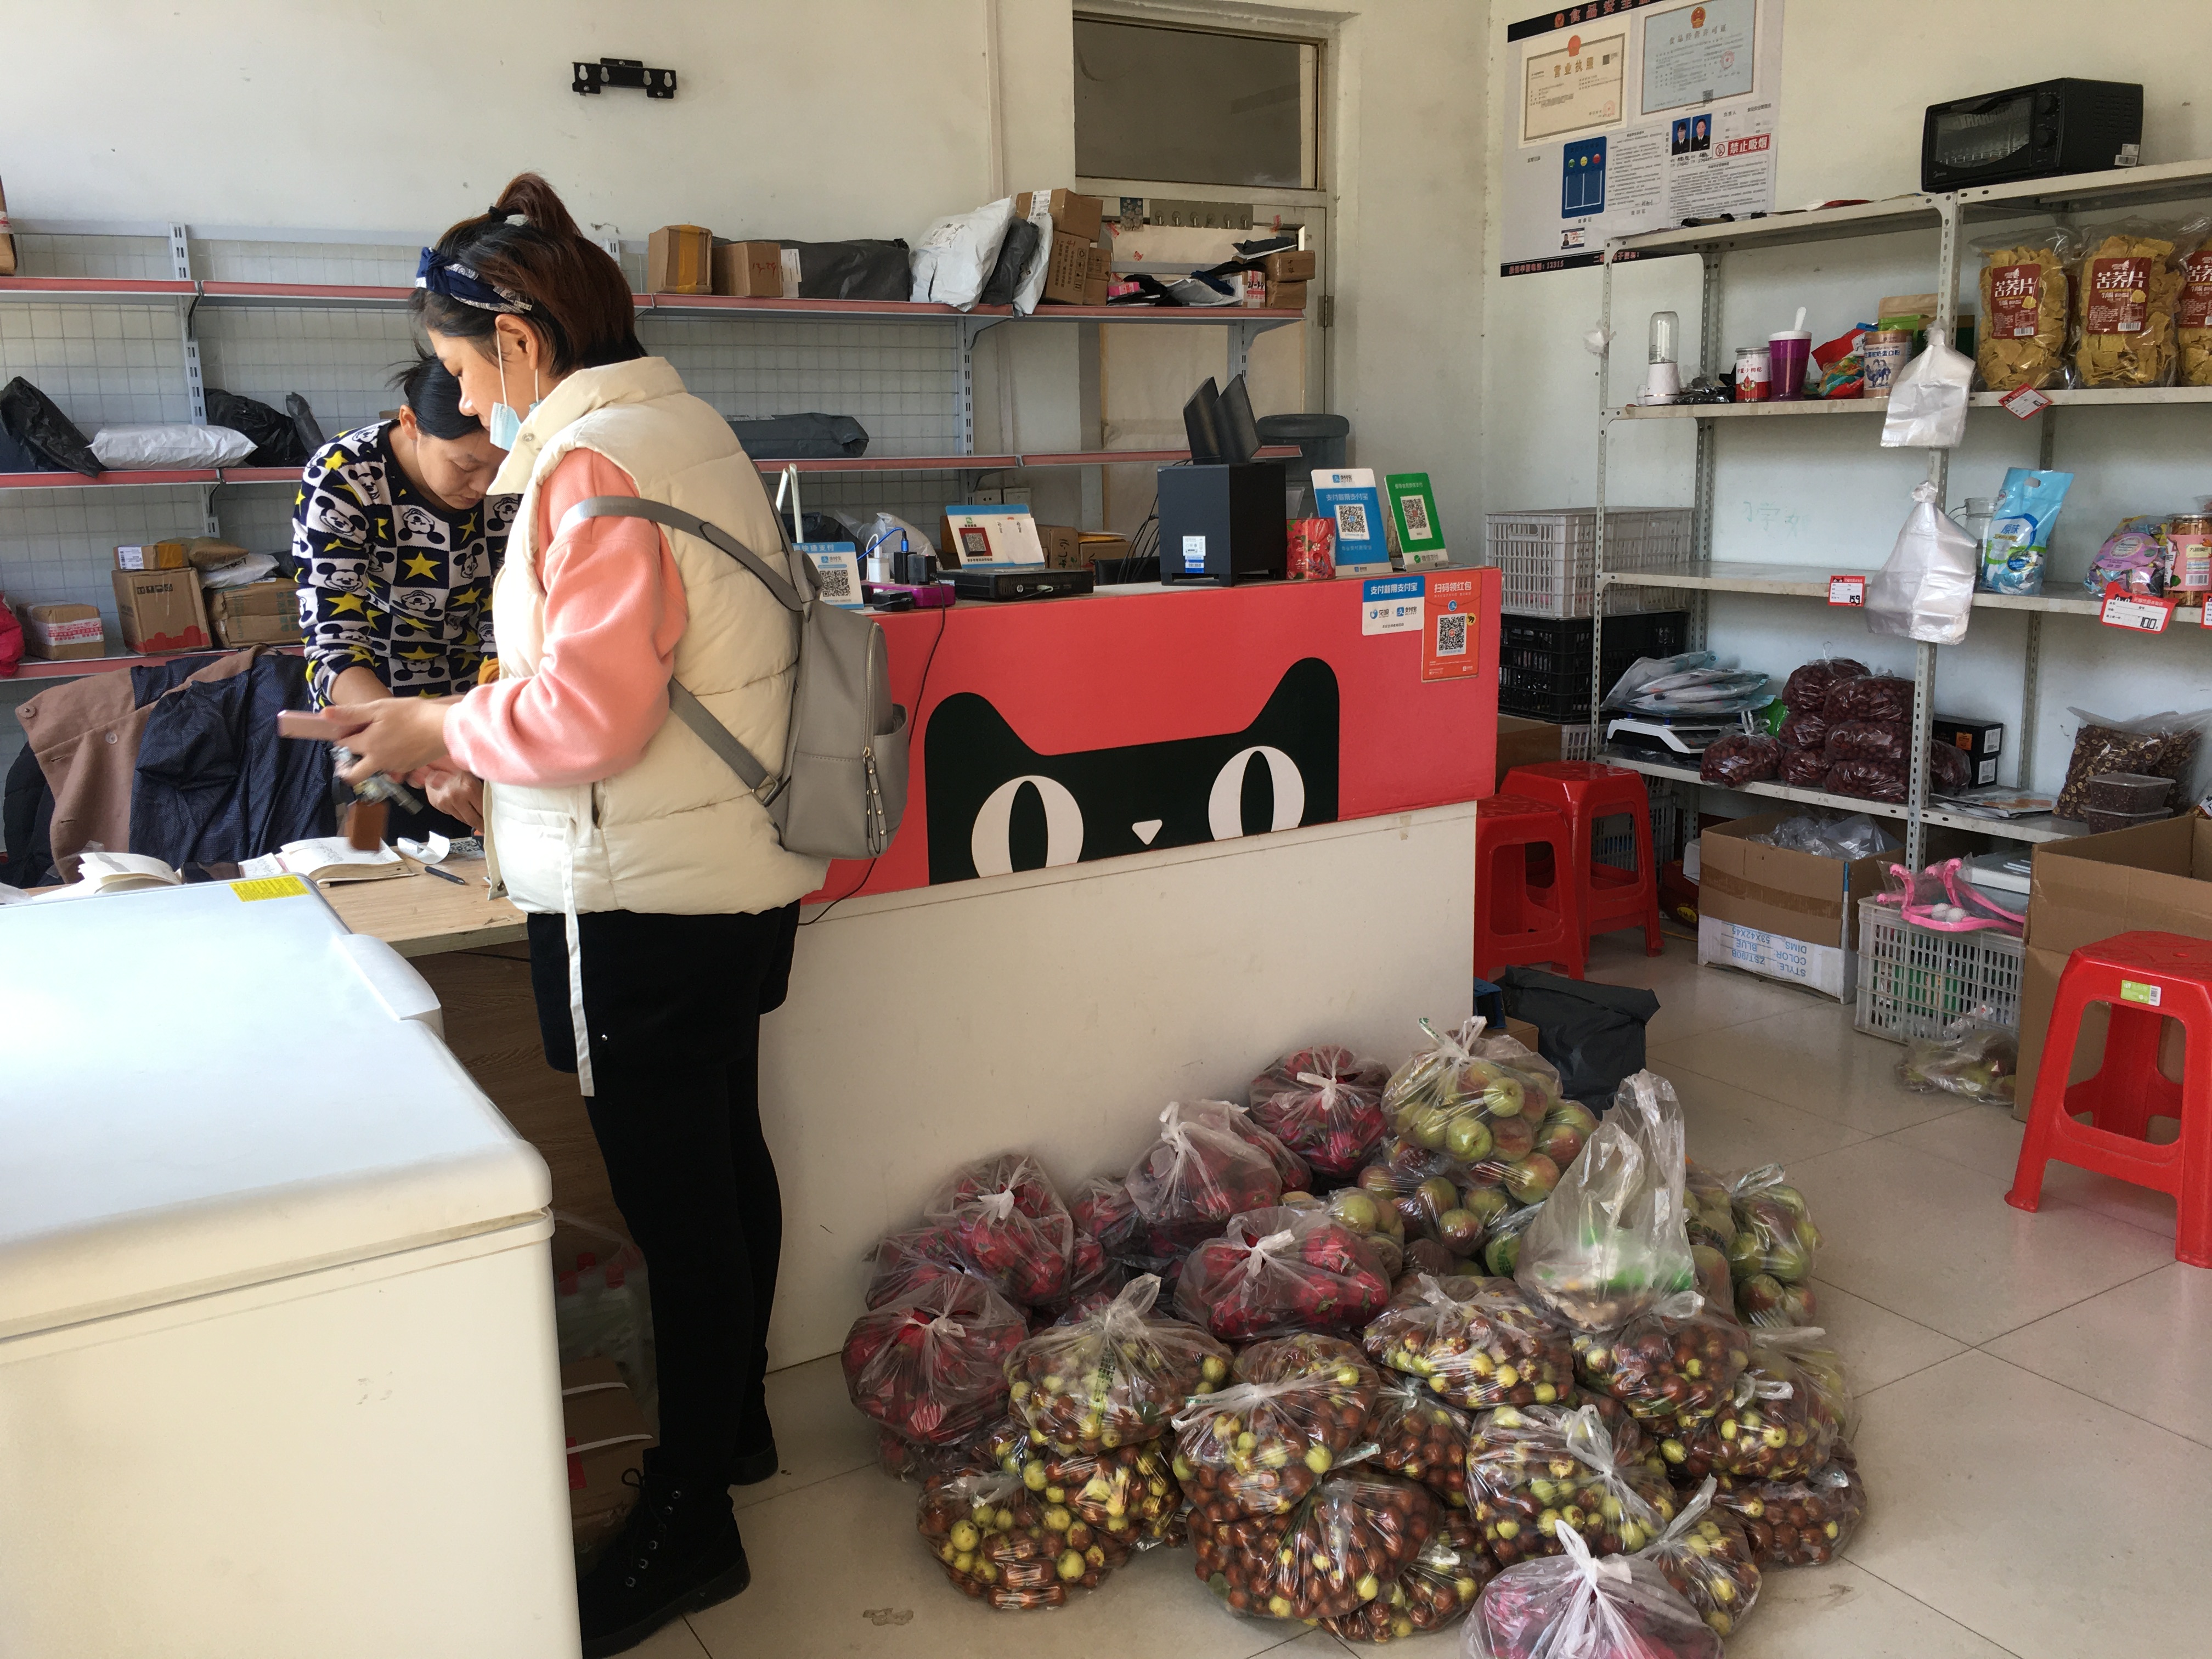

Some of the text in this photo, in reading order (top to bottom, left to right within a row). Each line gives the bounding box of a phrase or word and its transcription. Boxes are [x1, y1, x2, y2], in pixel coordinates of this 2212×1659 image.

[1553, 57, 1594, 78] 营业执照
[1730, 136, 1768, 154] 禁止吸烟
[2096, 270, 2147, 289] 苦荞片
[1995, 277, 2036, 298] 苦荞片
[1326, 493, 1369, 501] 支付就用支付宝
[2000, 524, 2021, 535] 原味
[1370, 582, 1418, 595] 支付就用支付宝
[1434, 581, 1472, 594] 扫码领红包
[1849, 595, 1860, 606] 159
[2132, 597, 2164, 607] 天猫优品体验店
[1379, 608, 1390, 616] 花呗
[2140, 617, 2157, 630] 100
[1731, 926, 1807, 955] DIMS 53X42X45
[1732, 950, 1765, 964] ZST/90B
[1736, 939, 1807, 966] COLOR: BLUE
